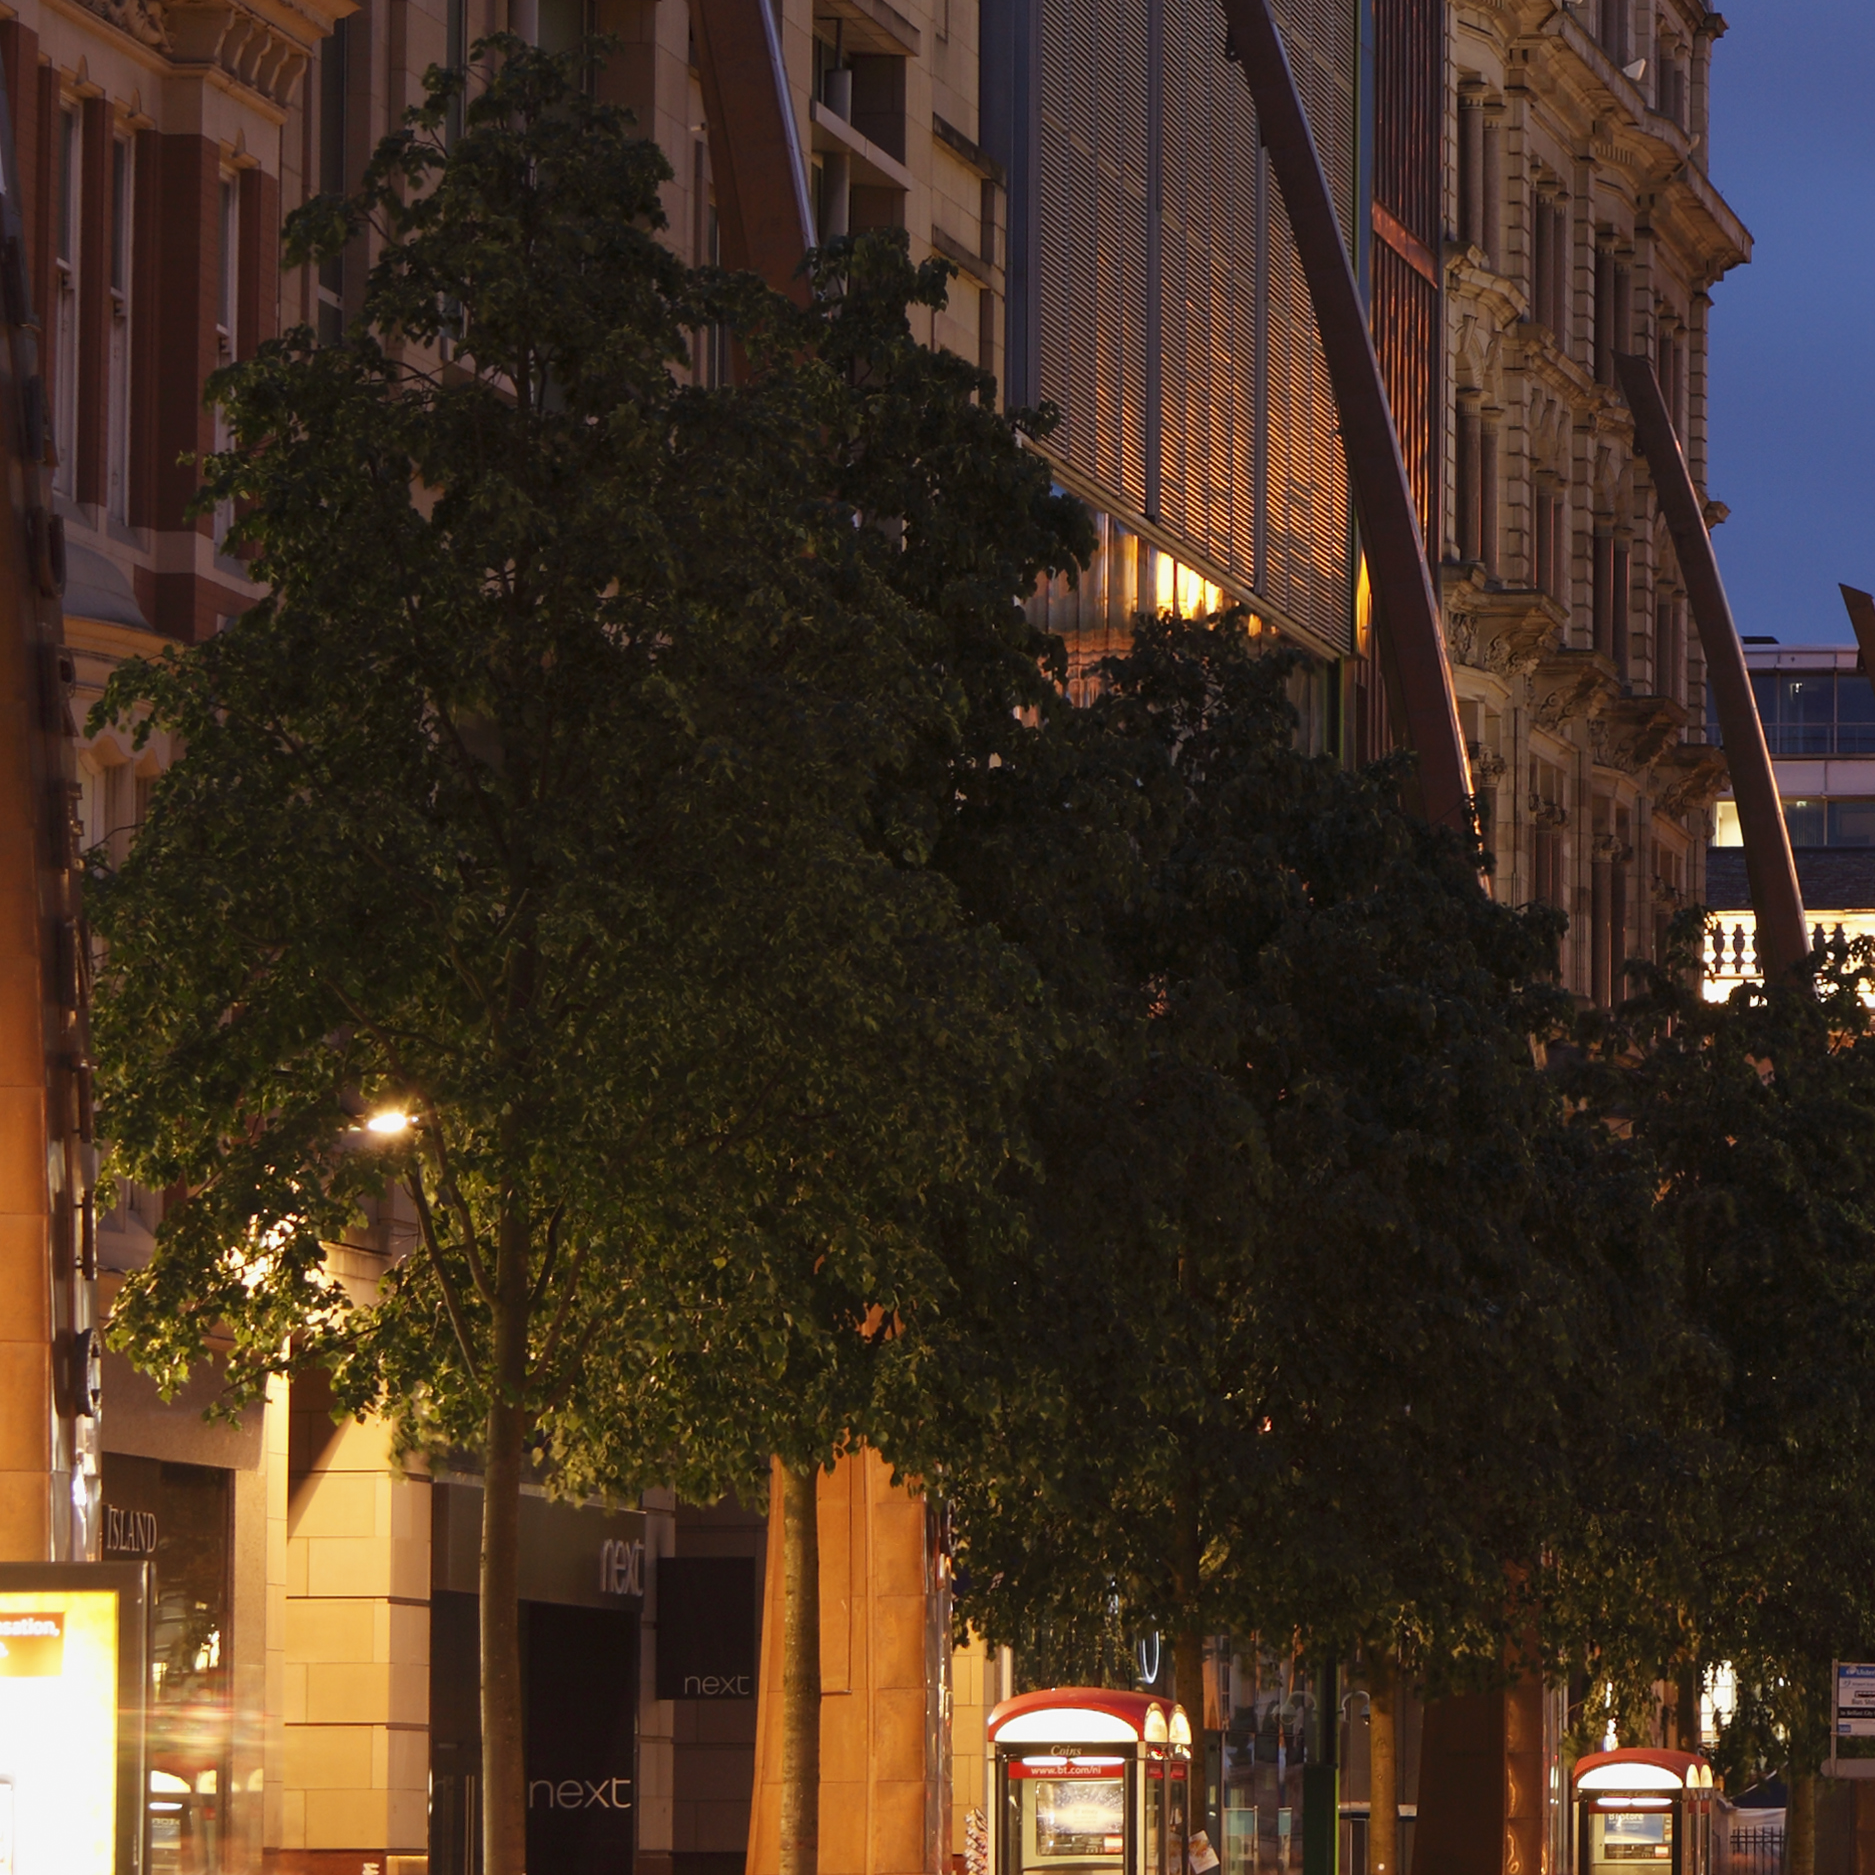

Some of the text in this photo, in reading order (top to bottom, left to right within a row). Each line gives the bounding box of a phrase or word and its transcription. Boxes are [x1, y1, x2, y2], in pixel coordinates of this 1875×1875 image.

[106, 1504, 158, 1553] ISLAND
[602, 1538, 644, 1597] next
[684, 1675, 750, 1695] next
[1051, 1745, 1082, 1756] Coins
[529, 1777, 632, 1809] next
